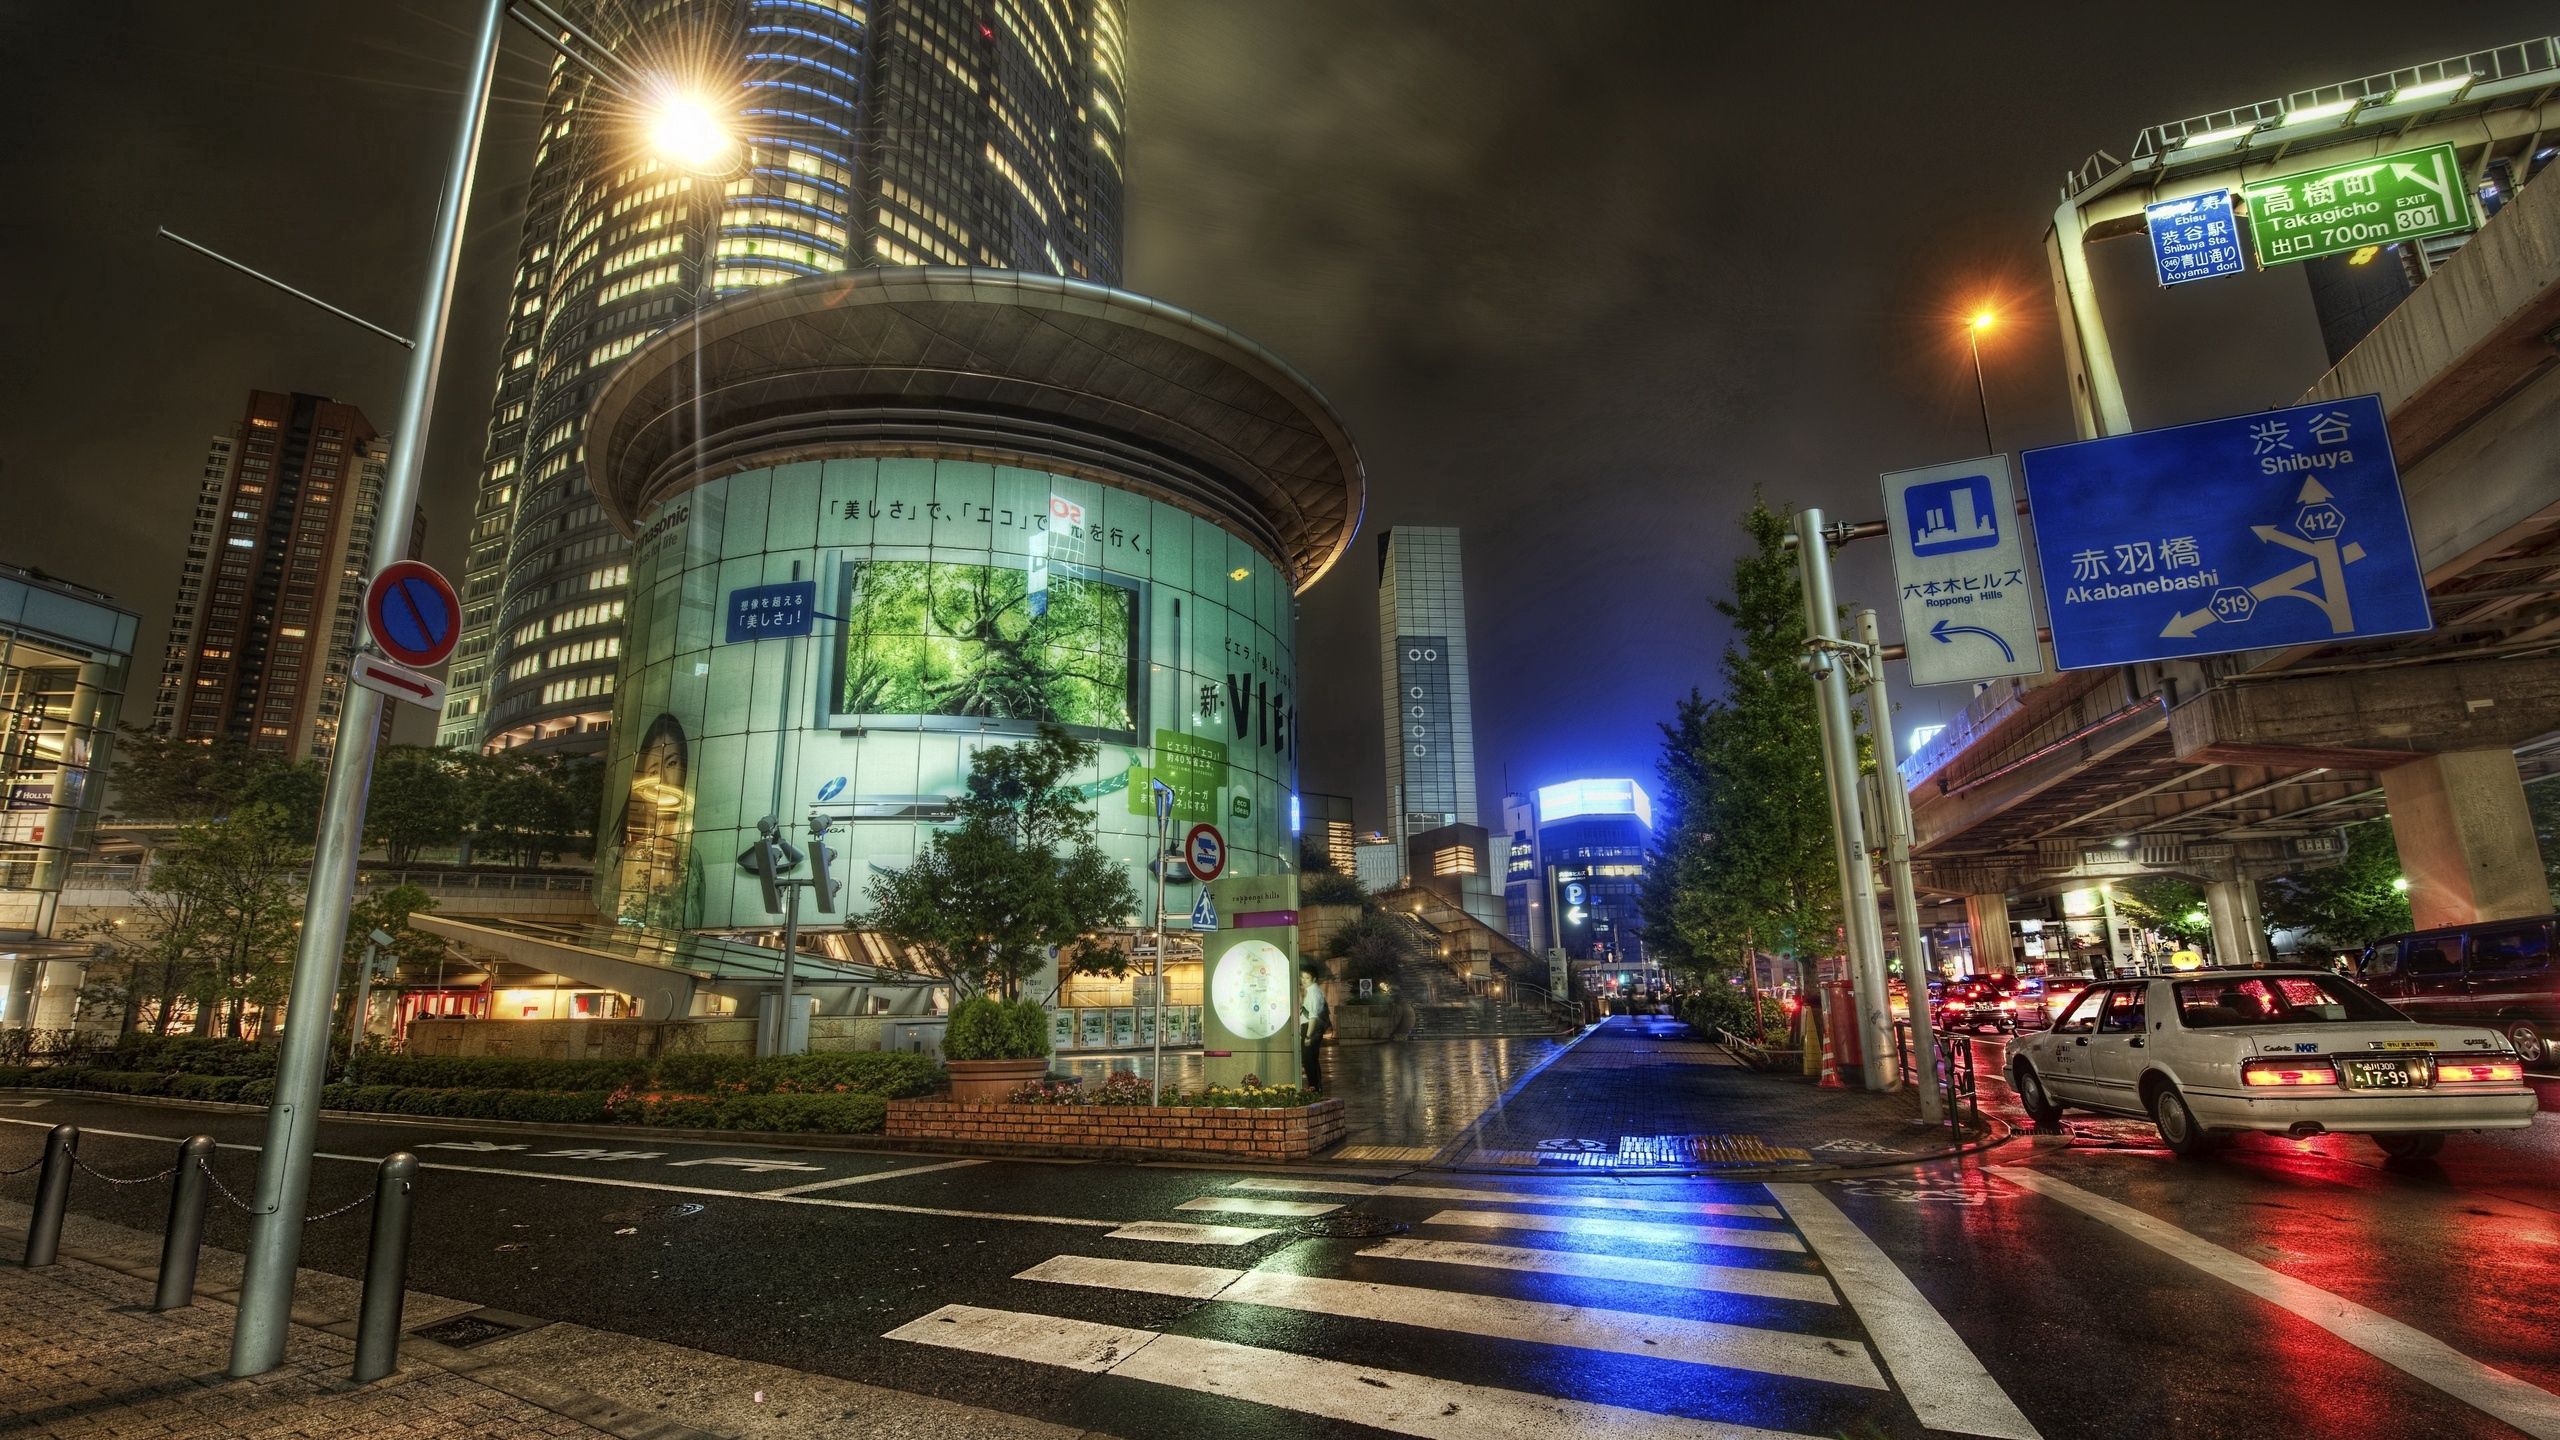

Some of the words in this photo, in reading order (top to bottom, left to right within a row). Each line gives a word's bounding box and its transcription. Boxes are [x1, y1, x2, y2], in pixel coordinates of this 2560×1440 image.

[2264, 173, 2377, 216] 高樹町
[2396, 193, 2428, 208] EXIT
[2175, 214, 2207, 226] Ebisu
[2268, 201, 2381, 231] Takagicho
[2399, 209, 2439, 230] 301
[2161, 220, 2228, 247] 渋谷駅
[2271, 235, 2314, 257] 出口
[2320, 222, 2391, 247] 700m
[2164, 240, 2206, 255] Shibuya
[2208, 237, 2229, 246] Sta.
[2164, 259, 2178, 268] 246
[2181, 245, 2236, 269] 青山通り
[2167, 267, 2210, 281] Aoyama
[2216, 260, 2238, 272] dori
[2249, 411, 2352, 456] 渋谷
[2260, 449, 2354, 475] Shibuya
[2303, 511, 2339, 531] 412
[2070, 535, 2201, 582] 赤羽橋
[1903, 568, 2024, 600] 六本木ヒルズ
[2064, 568, 2220, 605] Akabanebashi
[741, 594, 803, 611] 想像を超える
[1926, 593, 1974, 608] Roppongi
[1980, 590, 2003, 601] Hills
[2216, 594, 2250, 615] 319
[1236, 800, 1247, 808] eco
[1264, 890, 1280, 900] hills
[1570, 886, 1582, 902] P
[2365, 1070, 2409, 1086] 17-99
